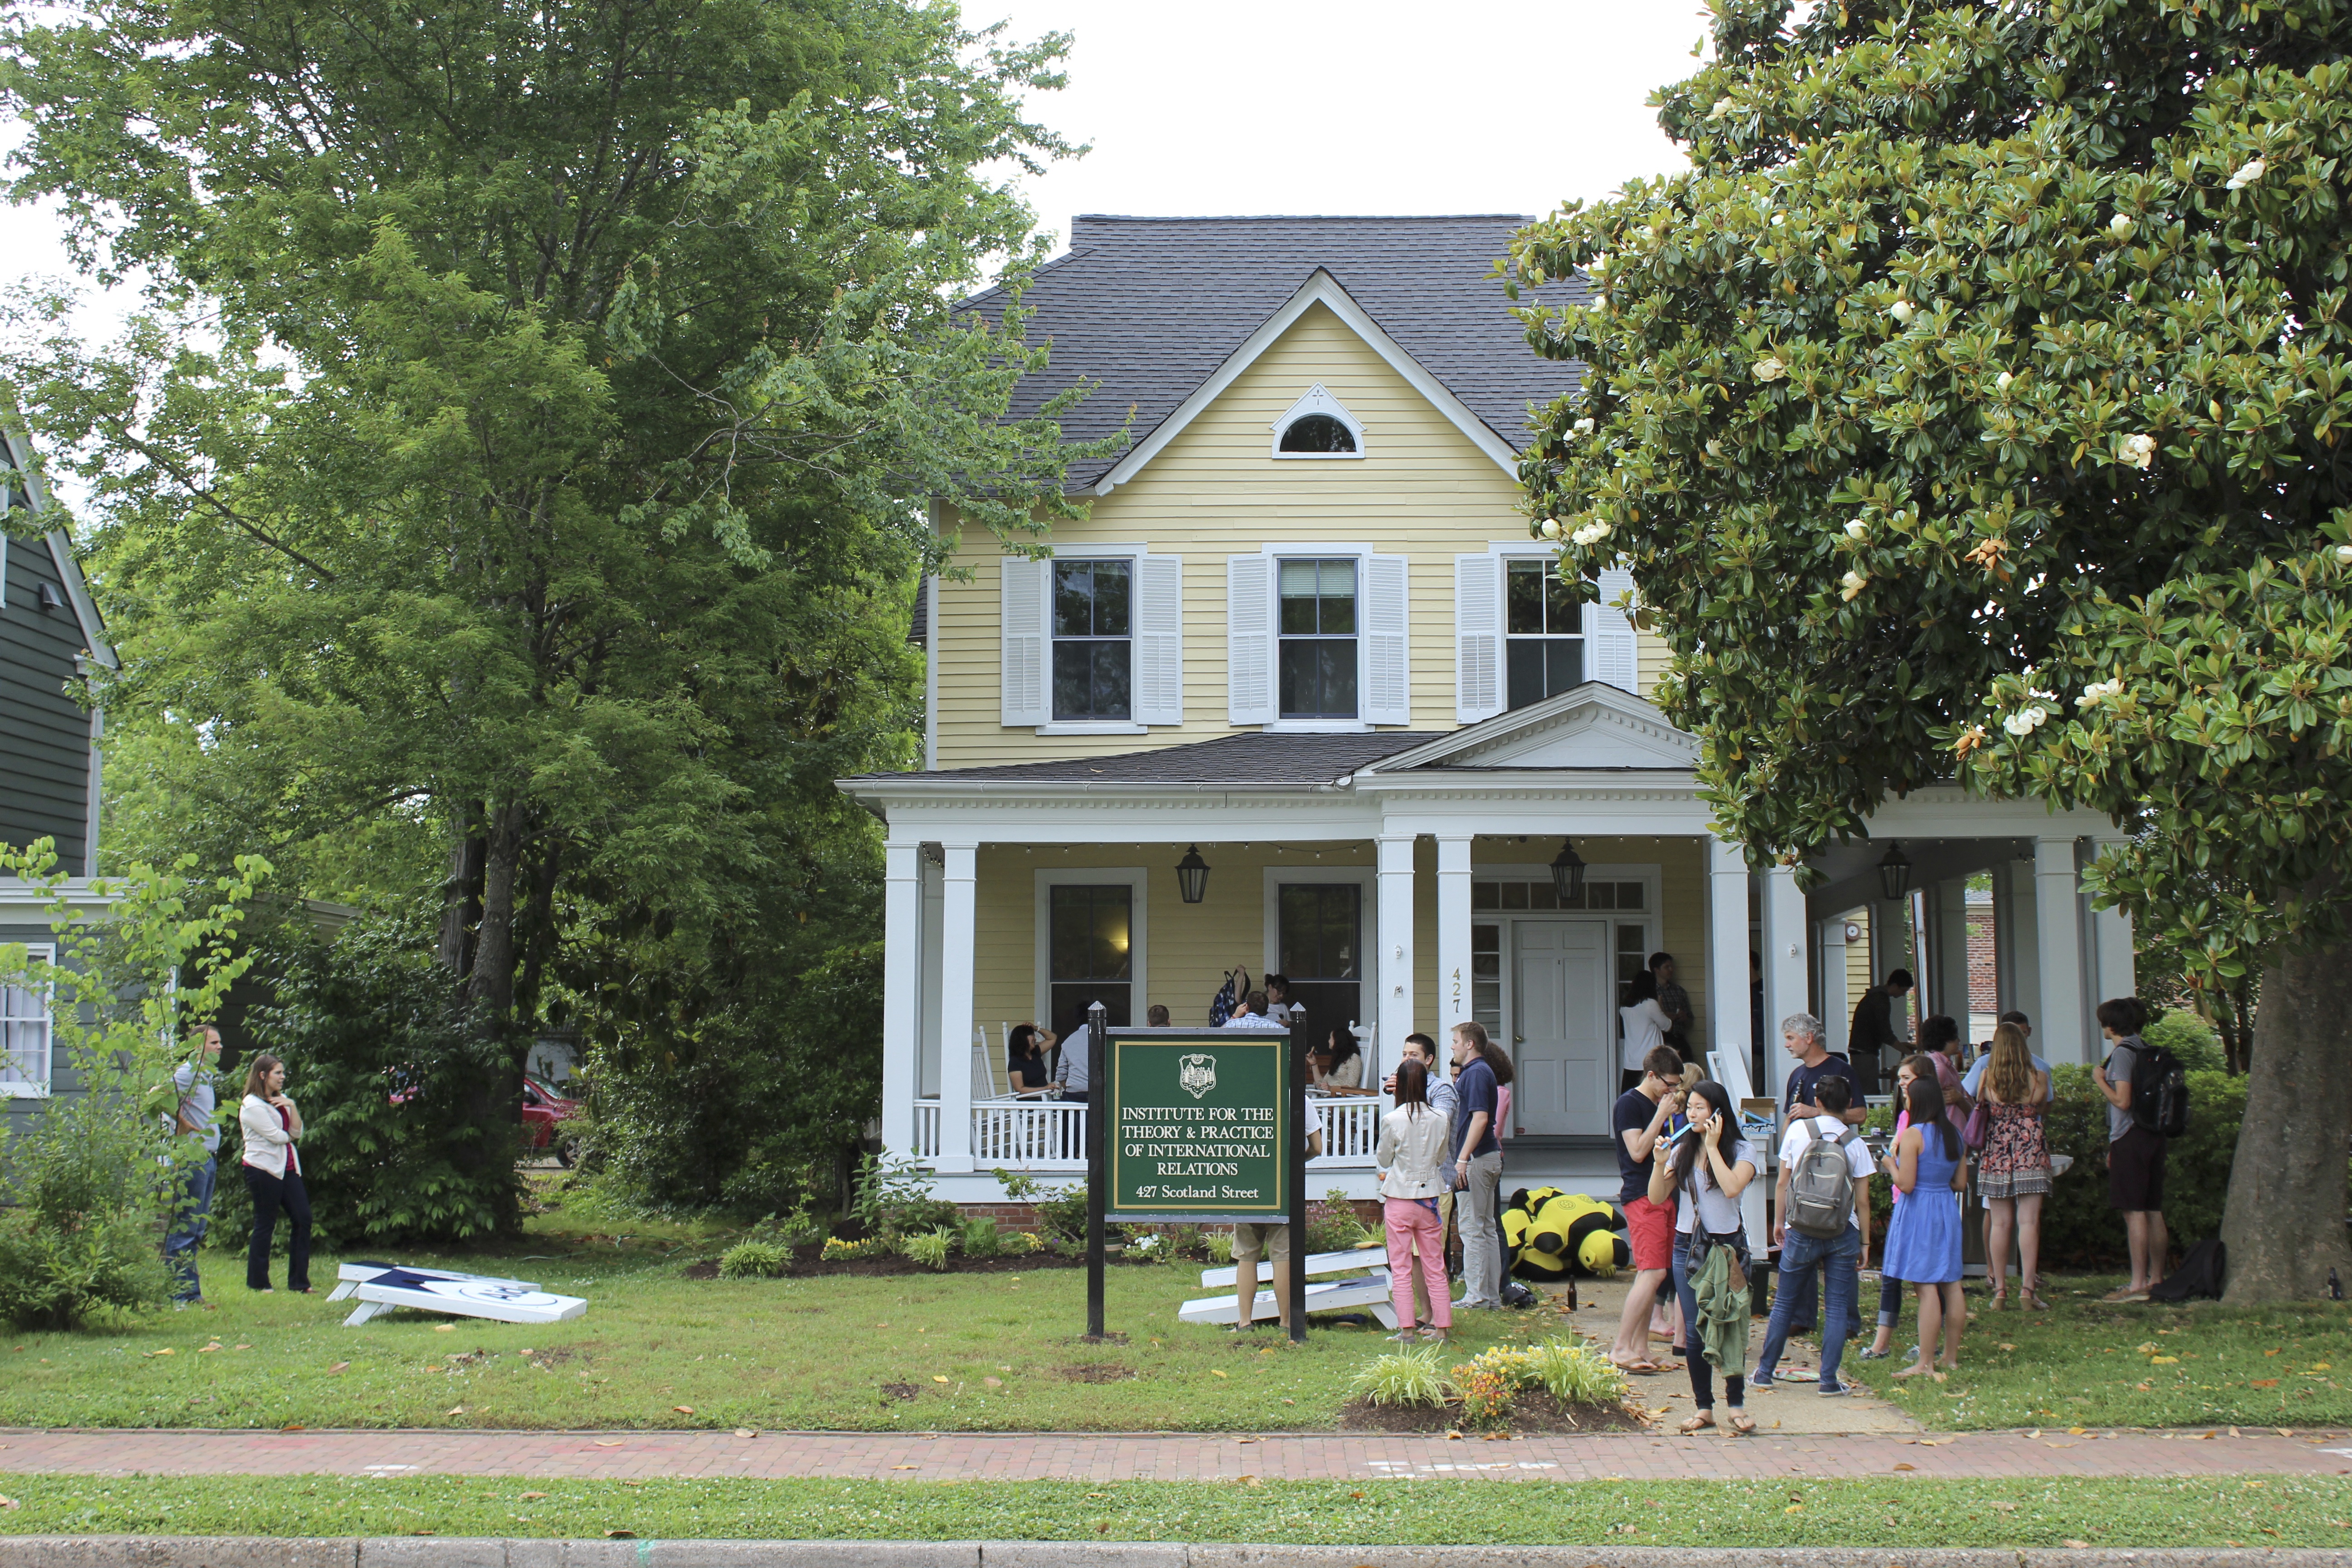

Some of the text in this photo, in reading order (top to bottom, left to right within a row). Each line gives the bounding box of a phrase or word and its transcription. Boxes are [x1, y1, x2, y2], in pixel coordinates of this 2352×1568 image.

[1452, 966, 1461, 1013] 427
[1122, 1107, 1274, 1121] INSTITUTE FOR THE
[1122, 1125, 1274, 1139] THEORY & PRACTICE
[1742, 1125, 1760, 1133] Pops
[1125, 1144, 1270, 1157] OF INTERNATIONAL
[1157, 1162, 1238, 1176] RELATIONS
[1135, 1185, 1259, 1198] 427 Scotland Street
